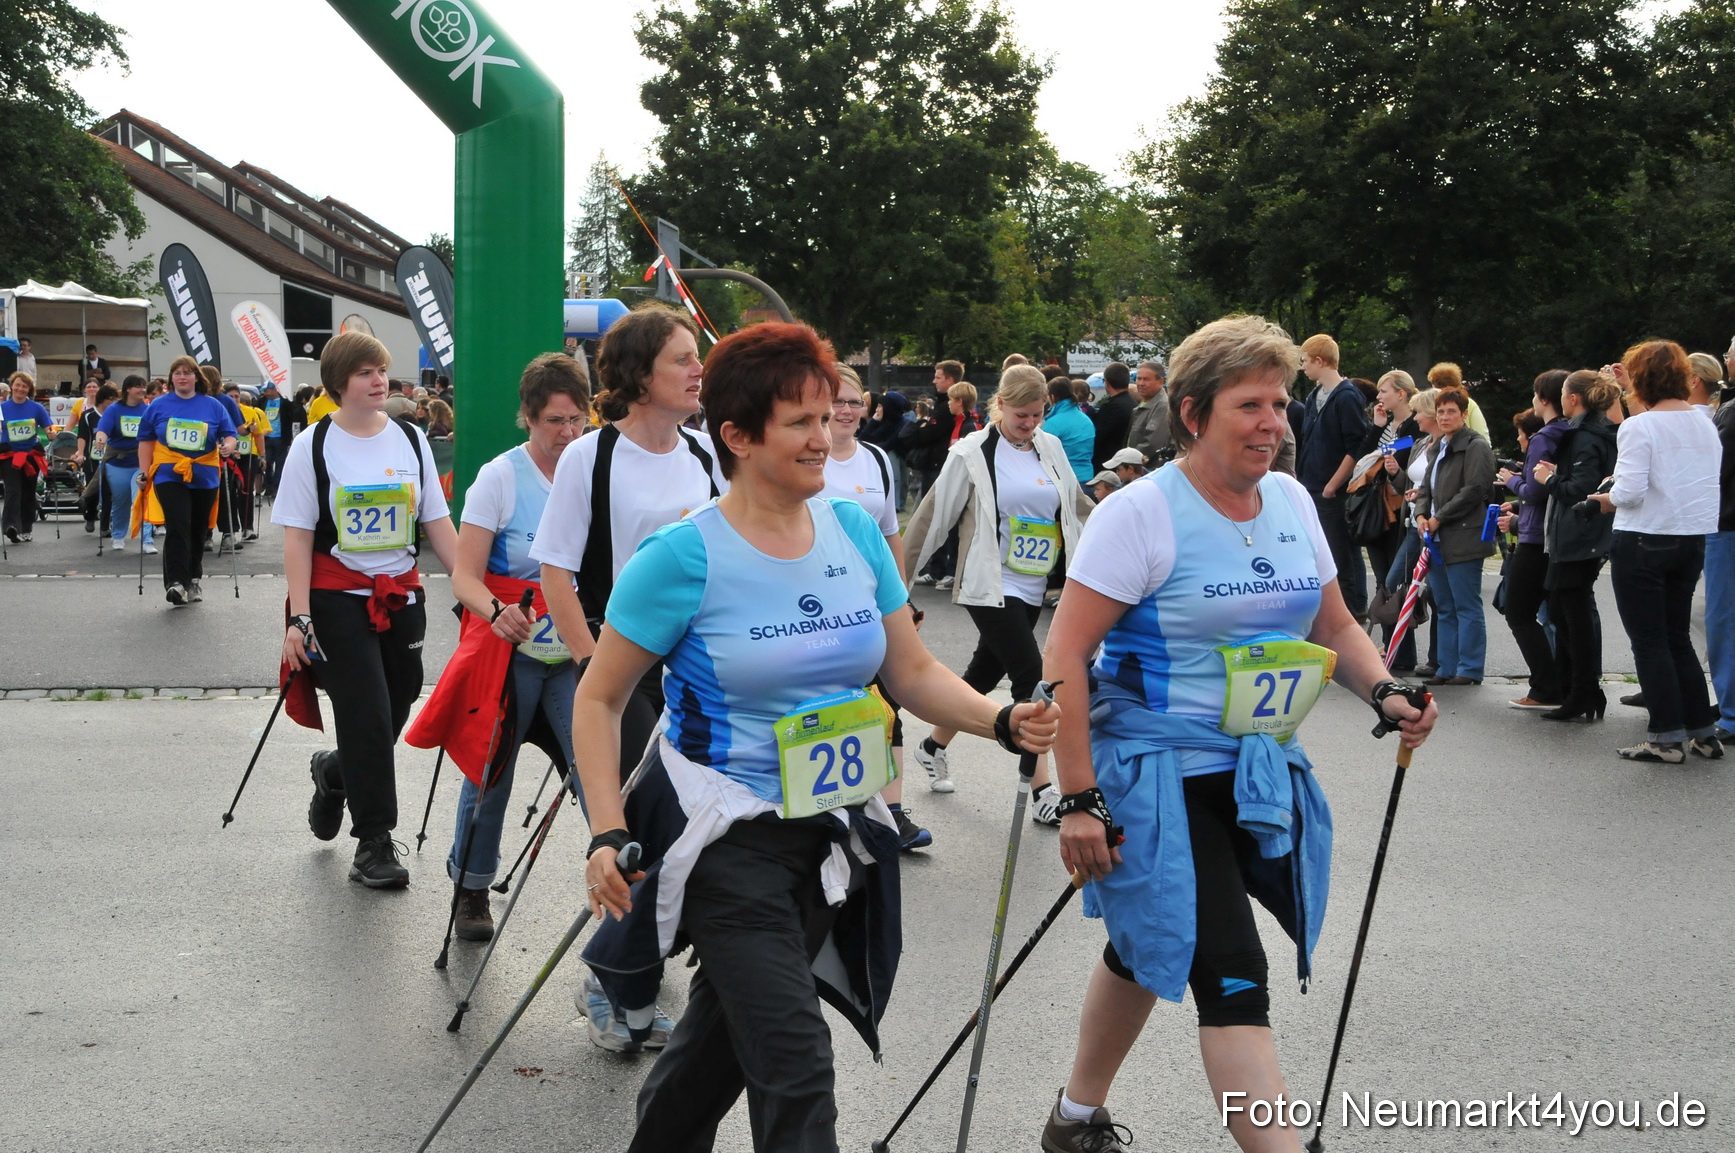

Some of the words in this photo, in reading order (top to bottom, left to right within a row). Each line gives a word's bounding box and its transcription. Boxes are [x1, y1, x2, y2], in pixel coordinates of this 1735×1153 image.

[391, 0, 521, 109] OK
[12, 426, 31, 436] 142
[124, 423, 140, 432] 12
[172, 428, 198, 443] 118
[346, 506, 396, 535] 321
[1013, 536, 1050, 561] 322
[1203, 577, 1320, 599] SCHABMÜLLER
[1255, 600, 1286, 611] TEAM
[750, 609, 876, 641] SCHABMÜLLER
[531, 644, 561, 653] Irmgard
[804, 636, 840, 650] TEAM
[1252, 670, 1302, 718] 27
[1252, 719, 1282, 730] Ursula
[809, 735, 864, 796] 28
[816, 793, 844, 810] Steffi
